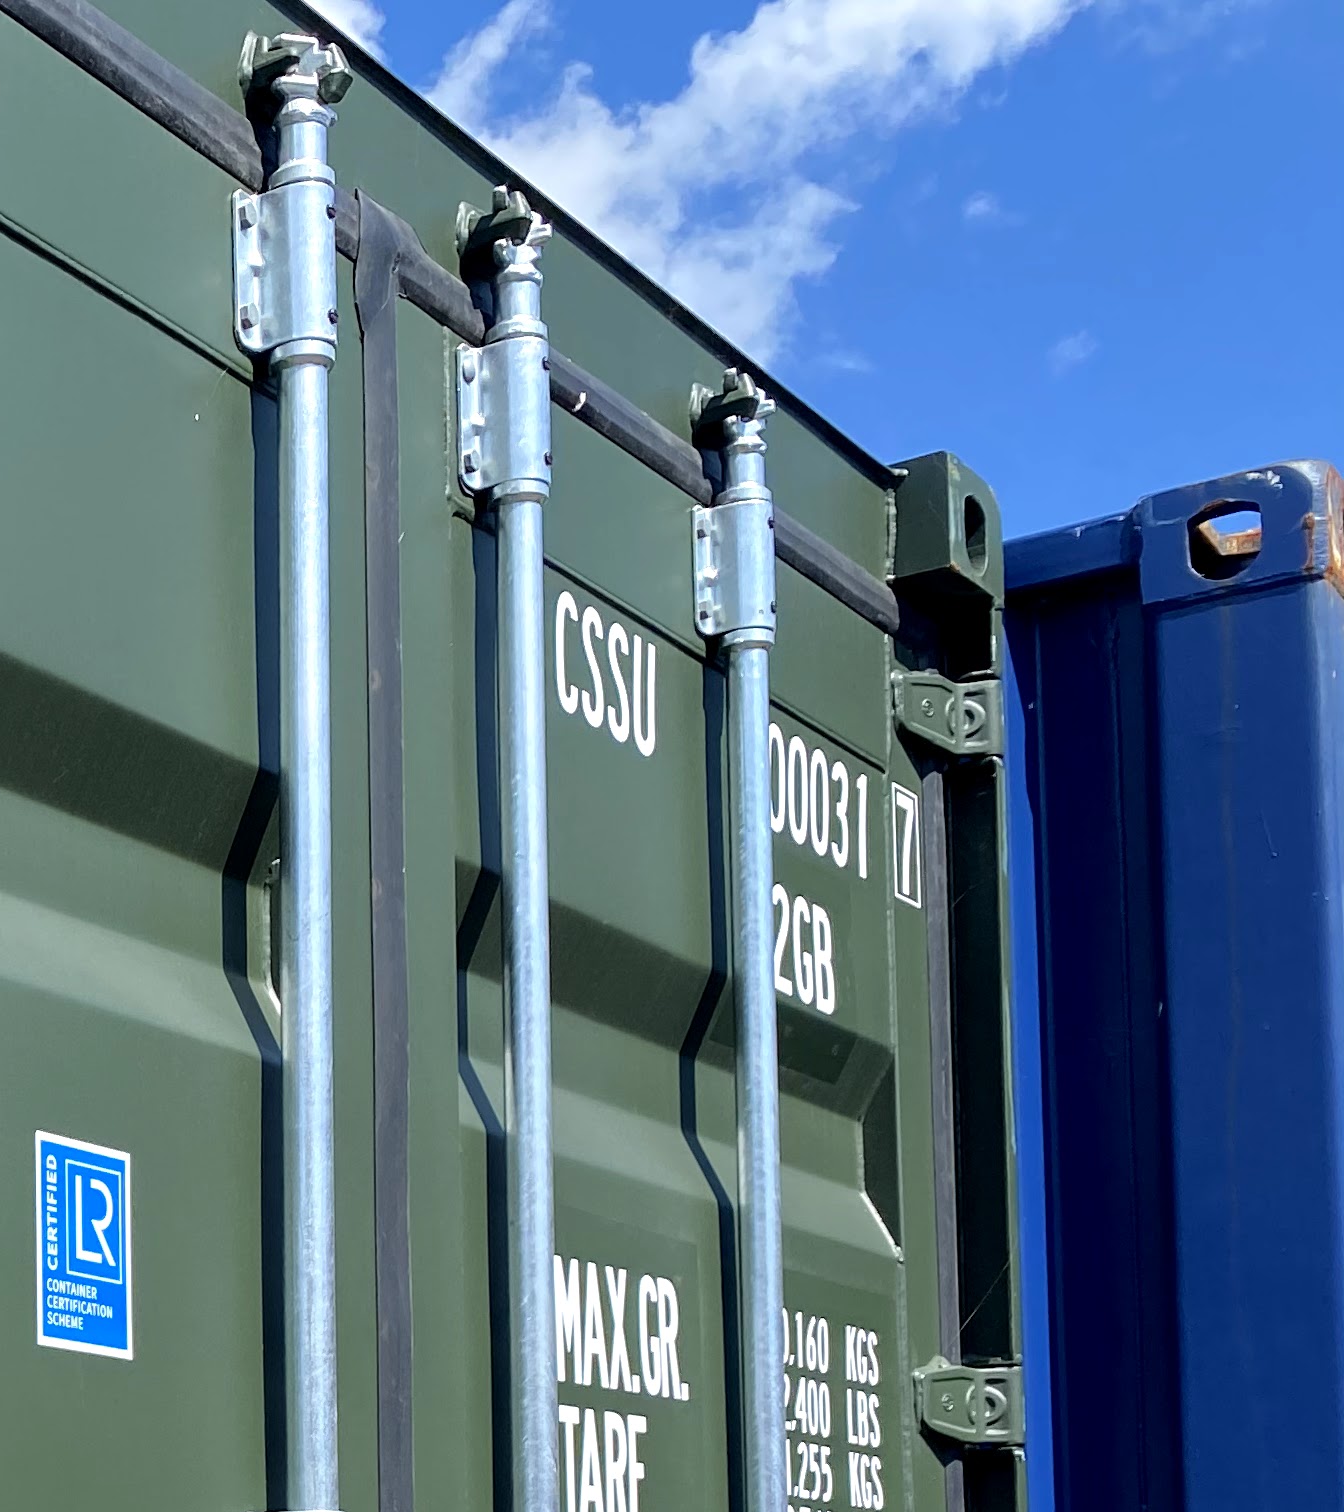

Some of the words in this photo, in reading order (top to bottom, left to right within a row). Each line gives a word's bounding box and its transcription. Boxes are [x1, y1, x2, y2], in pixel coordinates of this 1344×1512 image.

[556, 591, 656, 756] CSSU
[768, 722, 867, 880] 00031
[895, 791, 915, 897] 7
[772, 882, 836, 1016] 2GB
[45, 1154, 59, 1272] CERTIFIED
[74, 1174, 116, 1267] LR
[46, 1277, 98, 1300] CONTAINER
[46, 1294, 113, 1319] CERTIFICATION
[47, 1311, 84, 1331] SCHEME
[553, 1254, 690, 1401] MAX.GR.
[845, 1324, 880, 1387] KGS
[847, 1387, 881, 1448] LBS
[848, 1451, 884, 1511] KGS
